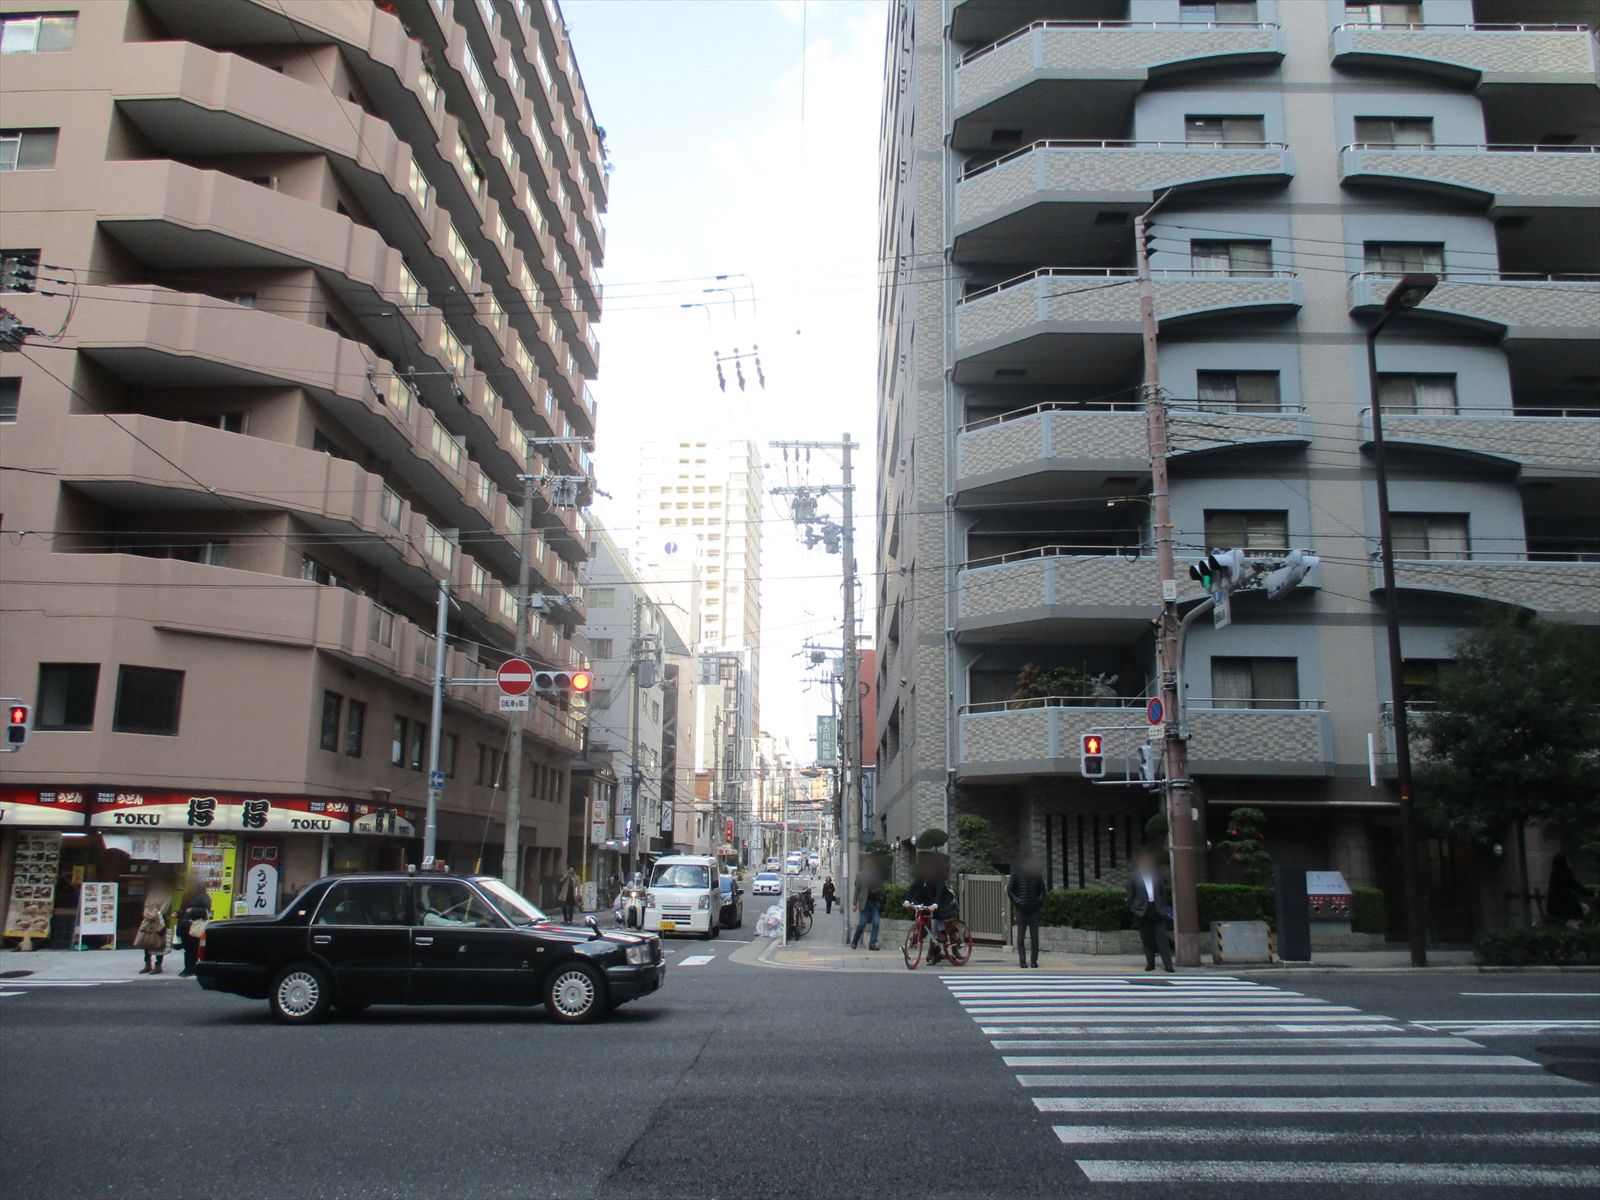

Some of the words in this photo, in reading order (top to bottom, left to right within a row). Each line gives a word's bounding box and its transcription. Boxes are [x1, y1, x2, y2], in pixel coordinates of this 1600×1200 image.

[58, 792, 83, 804] うどん
[117, 793, 144, 805] うどん
[326, 802, 349, 813] うどん
[113, 813, 161, 826] TOKU
[291, 818, 331, 831] TOKU
[255, 869, 267, 909] うどん
